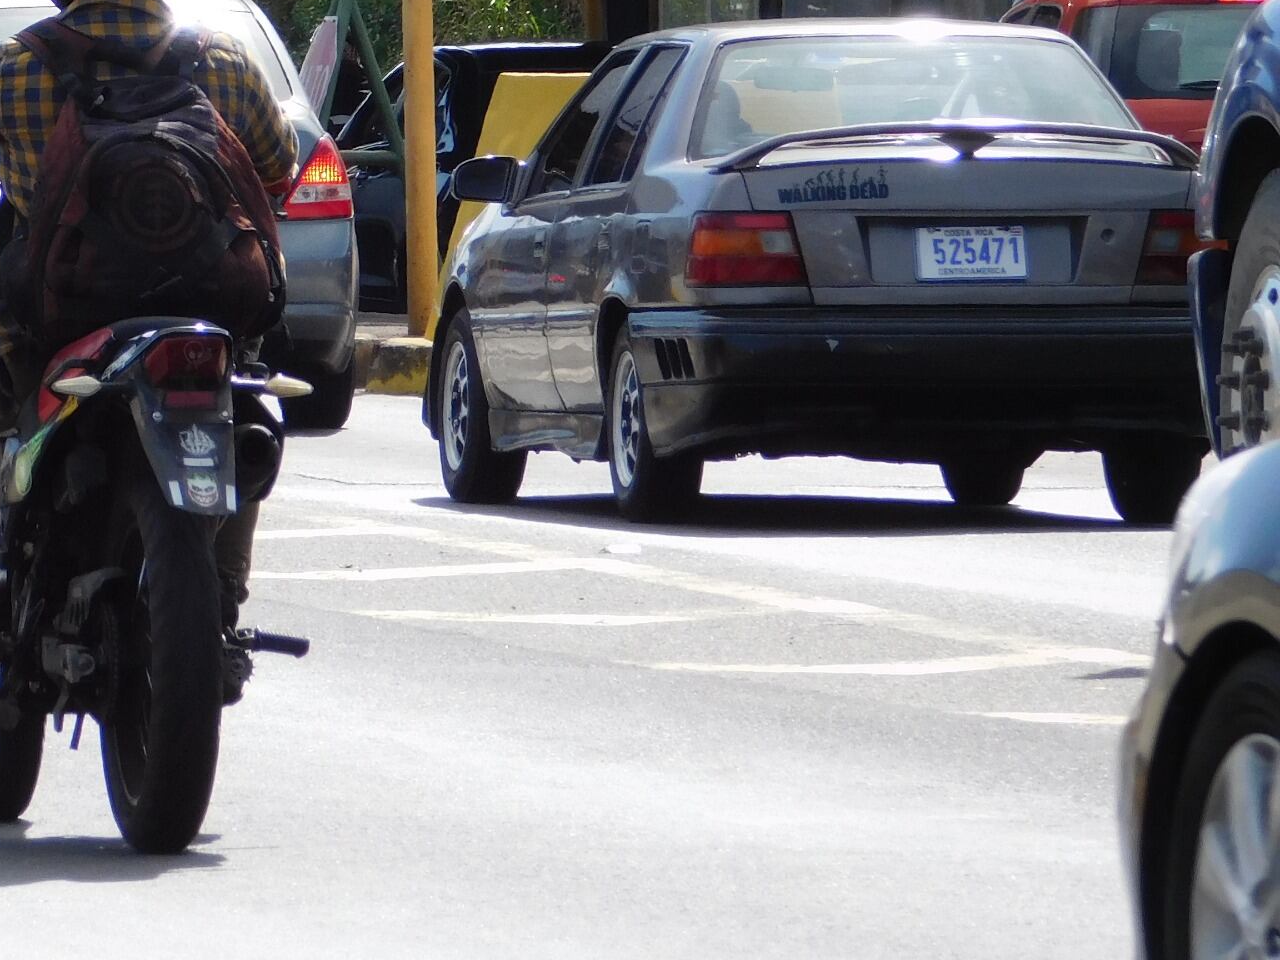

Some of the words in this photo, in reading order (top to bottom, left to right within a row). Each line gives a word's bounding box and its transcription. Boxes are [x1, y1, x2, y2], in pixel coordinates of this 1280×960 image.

[777, 185, 847, 204] WALKING
[849, 182, 889, 200] DEAD
[943, 229, 971, 237] COSTA
[974, 228, 994, 236] RICA
[932, 237, 1019, 265] 525471
[938, 267, 1007, 276] CENTROAMERICA
